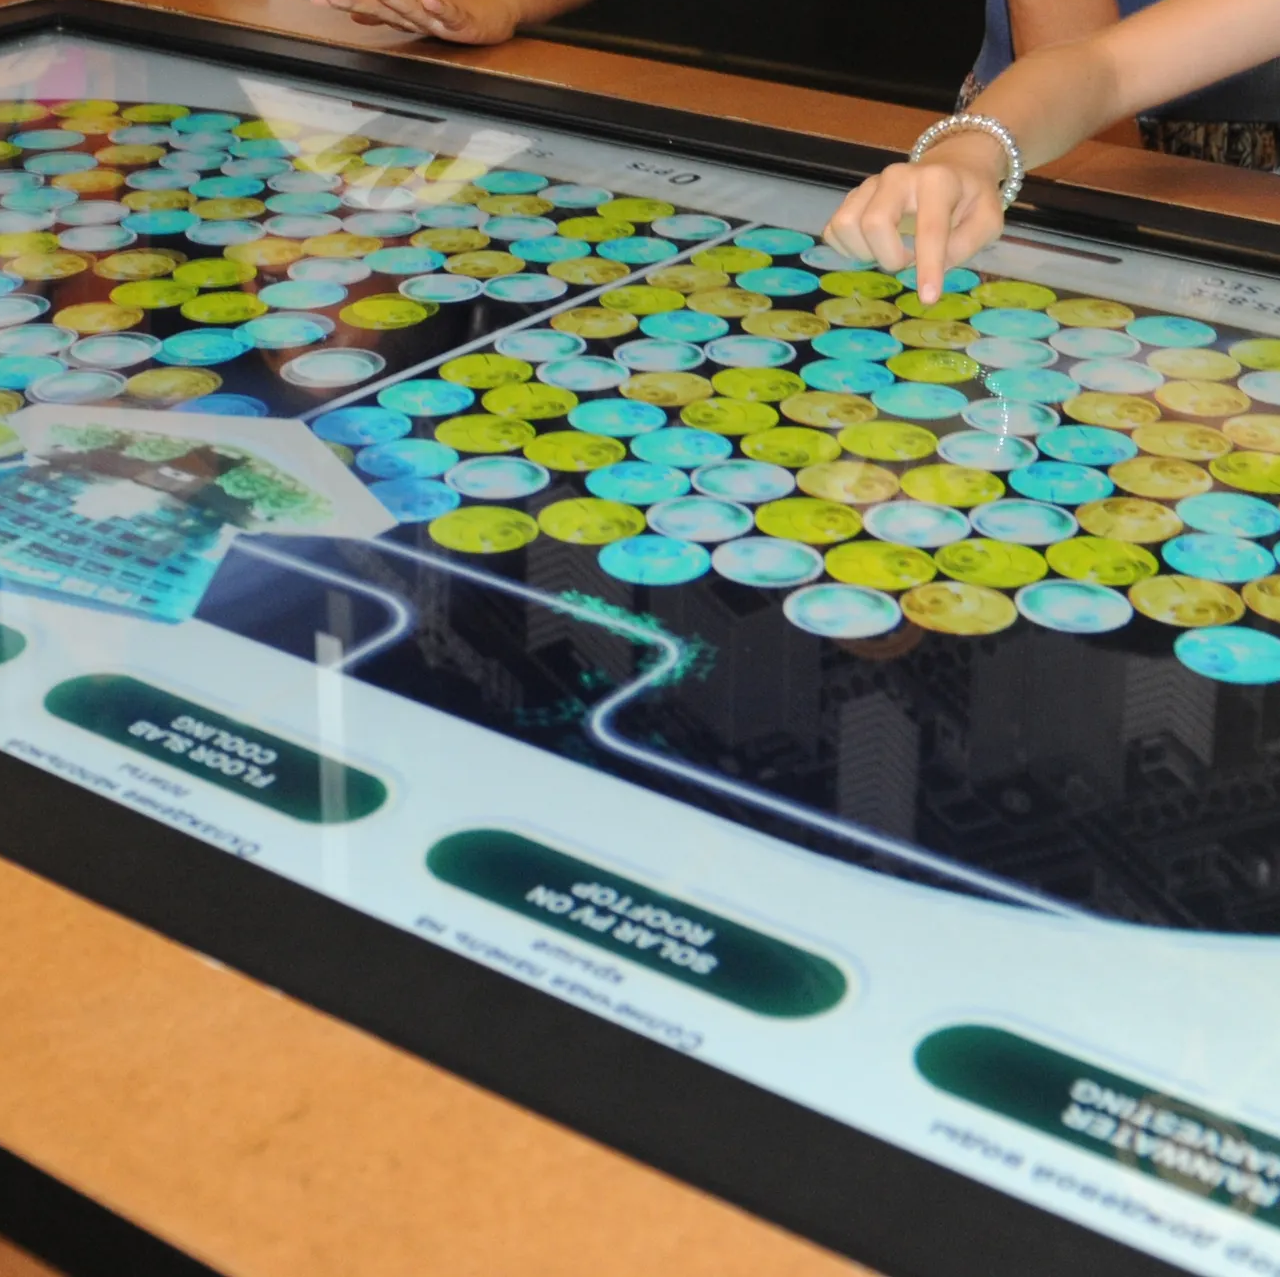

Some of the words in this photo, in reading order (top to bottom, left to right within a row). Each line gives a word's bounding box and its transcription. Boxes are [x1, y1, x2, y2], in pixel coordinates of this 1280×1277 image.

[127, 719, 195, 754] SLAB
[170, 714, 279, 766] COOLING
[187, 744, 277, 789] FLOOR
[524, 883, 575, 915] ON
[568, 904, 620, 933] PV
[569, 880, 717, 948] ROOFTOP
[612, 921, 720, 976] SOLAR
